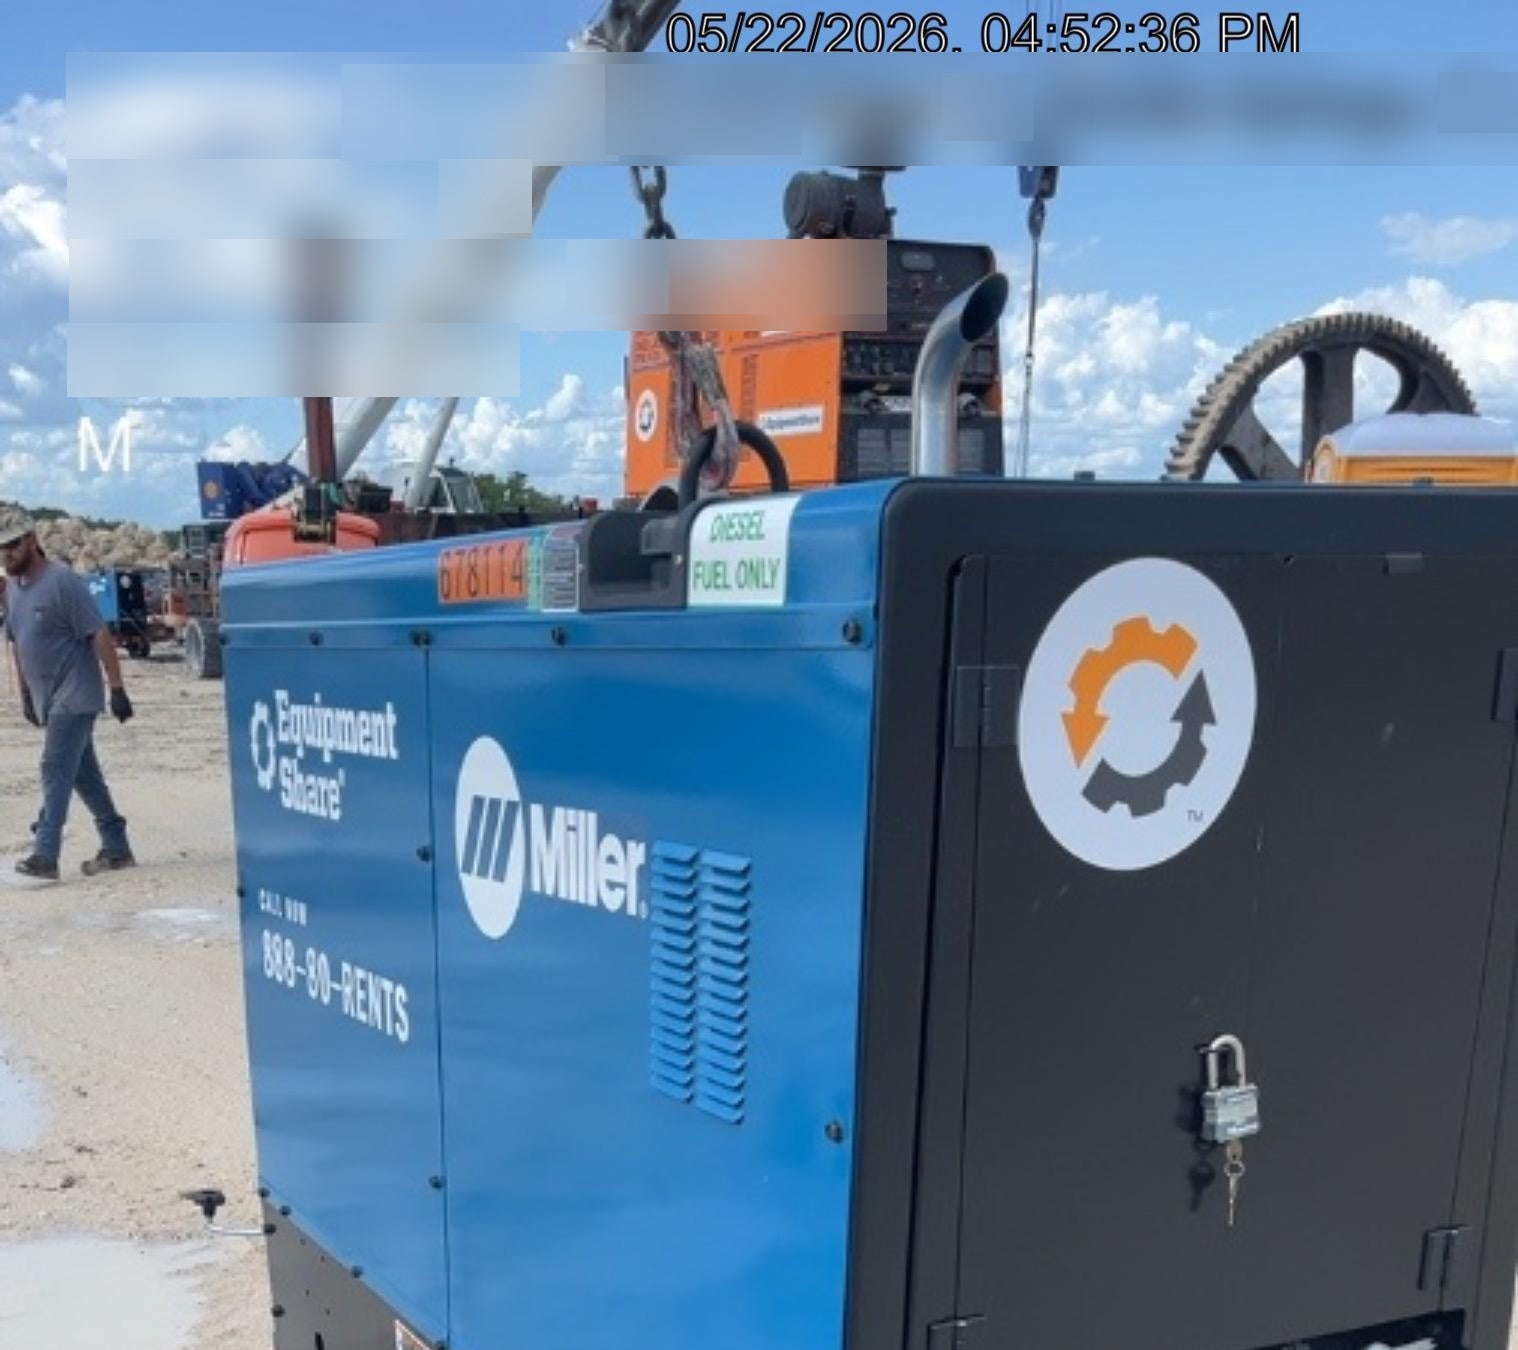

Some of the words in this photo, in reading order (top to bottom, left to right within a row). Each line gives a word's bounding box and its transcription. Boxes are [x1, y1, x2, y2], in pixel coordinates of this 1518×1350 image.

[709, 510, 766, 543] DIESEL
[440, 541, 525, 600] 678114
[693, 560, 732, 592] FUEL
[735, 557, 781, 589] ONLY
[274, 689, 398, 763] Equipment
[262, 929, 409, 1042] 888-80-RENTS
